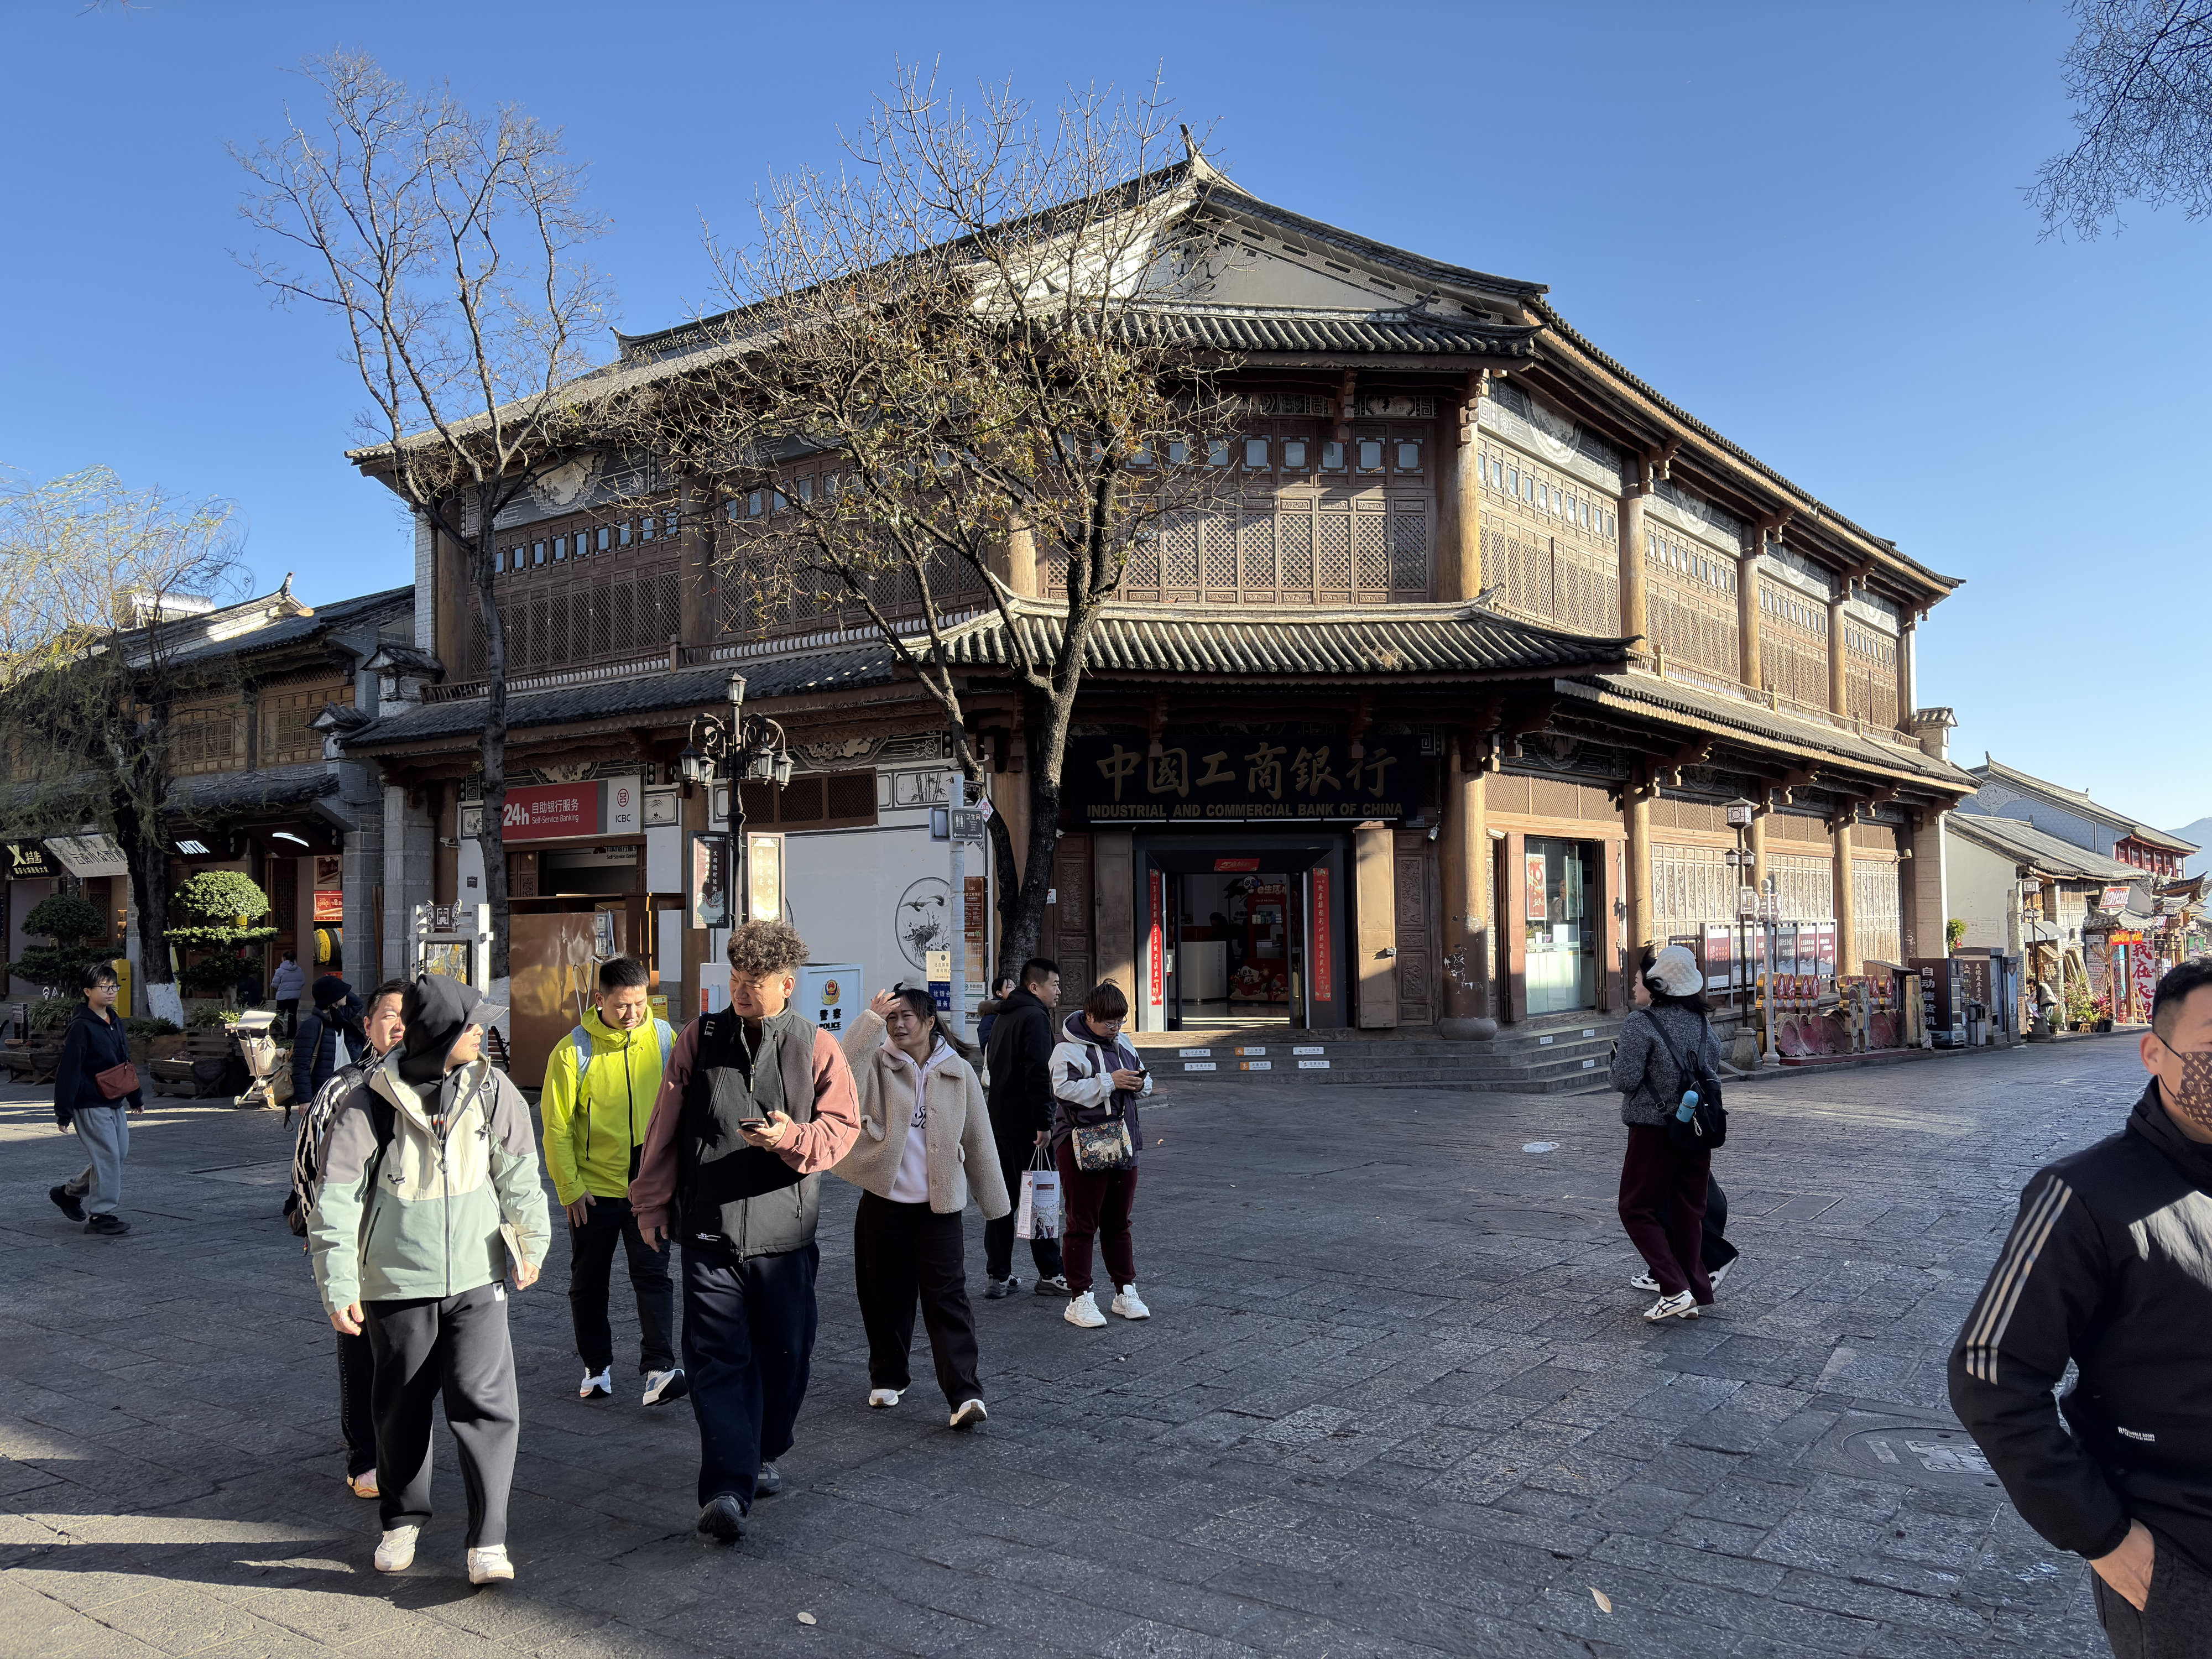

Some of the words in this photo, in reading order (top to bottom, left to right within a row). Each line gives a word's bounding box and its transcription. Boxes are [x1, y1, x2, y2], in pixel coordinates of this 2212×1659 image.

[1097, 742, 1397, 801] 中國工商銀行
[532, 799, 578, 814] 自助银行服务
[1087, 805, 1167, 817] INDUSTRIAL
[1173, 805, 1201, 817] AND
[1206, 804, 1292, 817] COMMERCIAL
[1298, 804, 1334, 816] BANK
[1340, 804, 1357, 816] OF
[1362, 803, 1403, 815] CHINA
[503, 803, 529, 826] 24h
[532, 816, 559, 824] Self-Service
[560, 813, 578, 822] Banking
[615, 814, 631, 823] ICBC
[175, 840, 210, 854] ANTA
[25, 851, 42, 864] 特步
[1921, 967, 1937, 1025] 自动售货机
[820, 1008, 841, 1021] 警察
